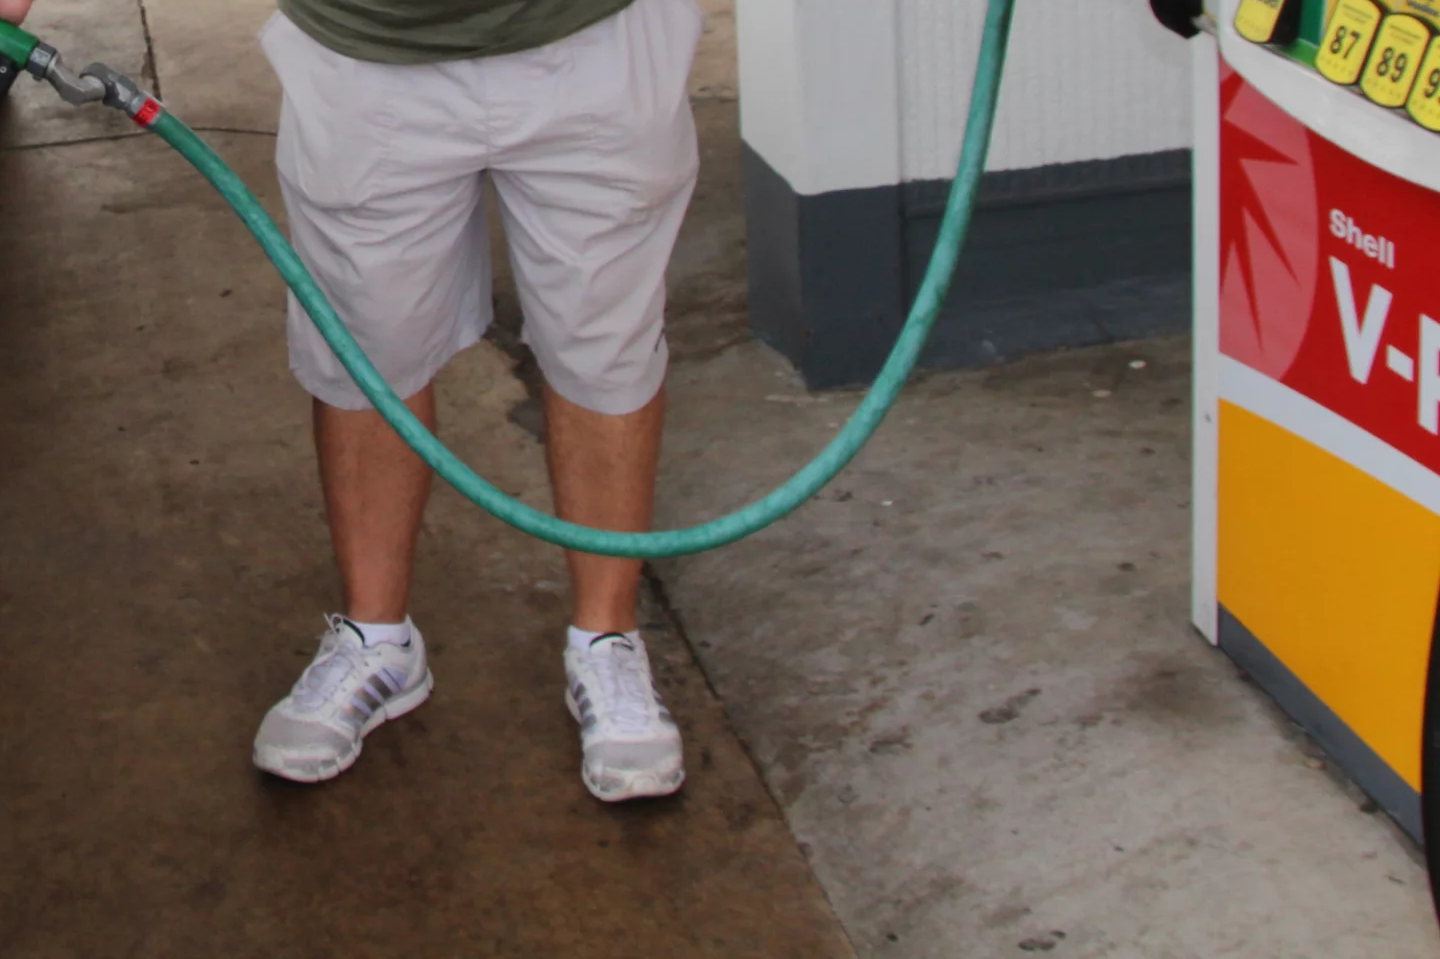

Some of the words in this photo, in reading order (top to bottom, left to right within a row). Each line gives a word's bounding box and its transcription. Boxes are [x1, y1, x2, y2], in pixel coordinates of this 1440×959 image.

[1330, 26, 1362, 60] 87
[1376, 46, 1408, 83] 89
[1423, 68, 1440, 105] 9
[1329, 208, 1395, 269] Shell
